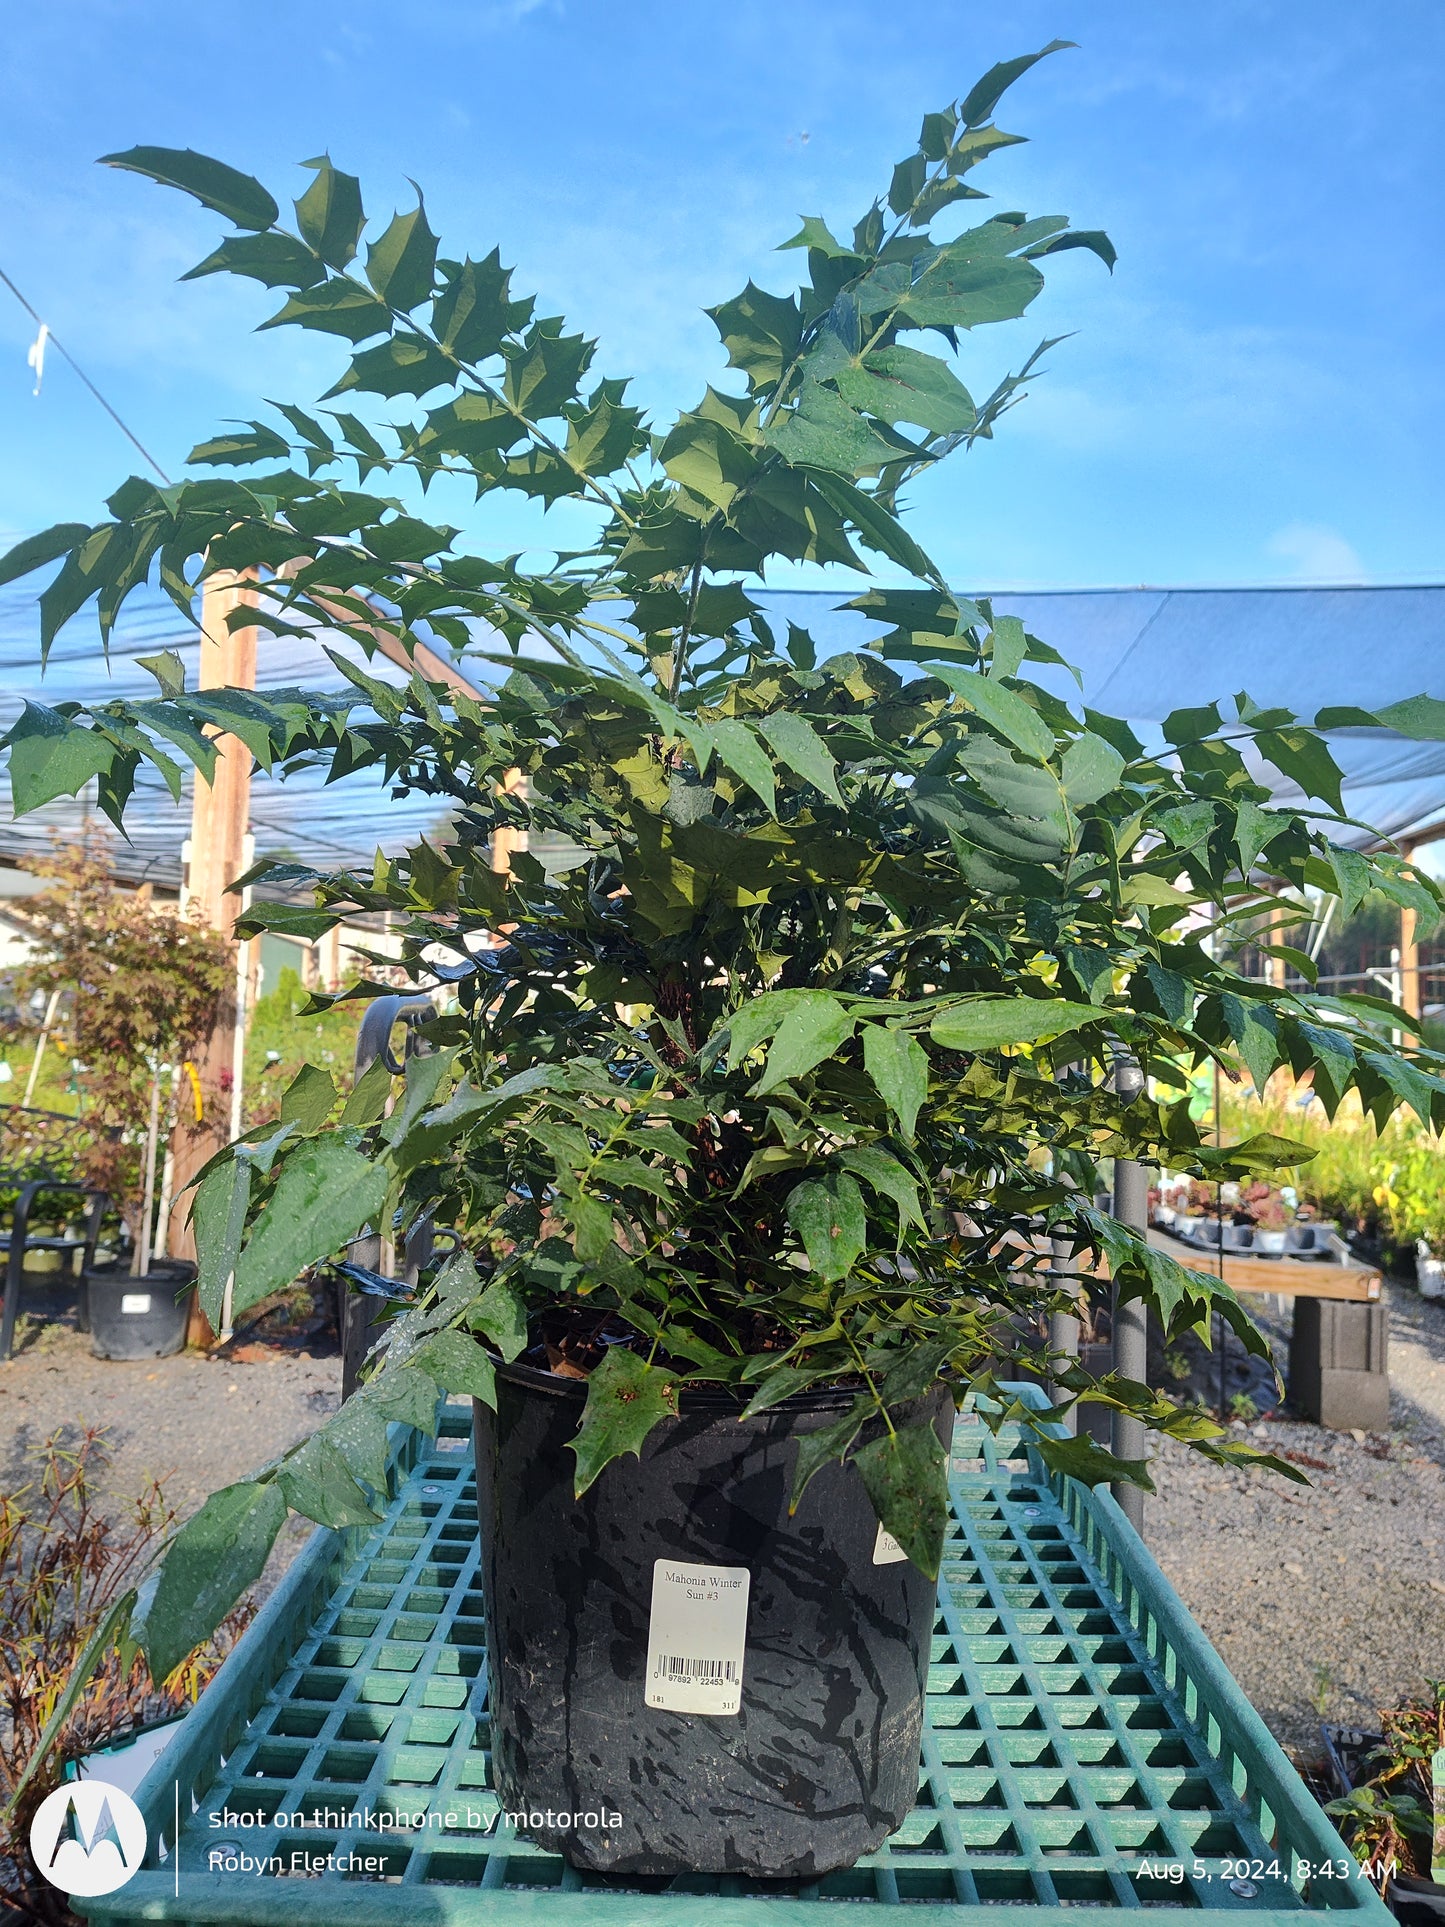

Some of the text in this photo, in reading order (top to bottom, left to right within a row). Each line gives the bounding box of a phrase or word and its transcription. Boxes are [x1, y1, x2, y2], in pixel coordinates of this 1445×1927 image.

[882, 1537, 901, 1551] 3 Ga
[665, 1571, 742, 1588] Mahonia Winter
[686, 1589, 719, 1601] Sun #3
[653, 1671, 659, 1679] 0
[668, 1674, 692, 1684] 97892
[700, 1678, 724, 1686] 22453
[652, 1695, 664, 1703] 181
